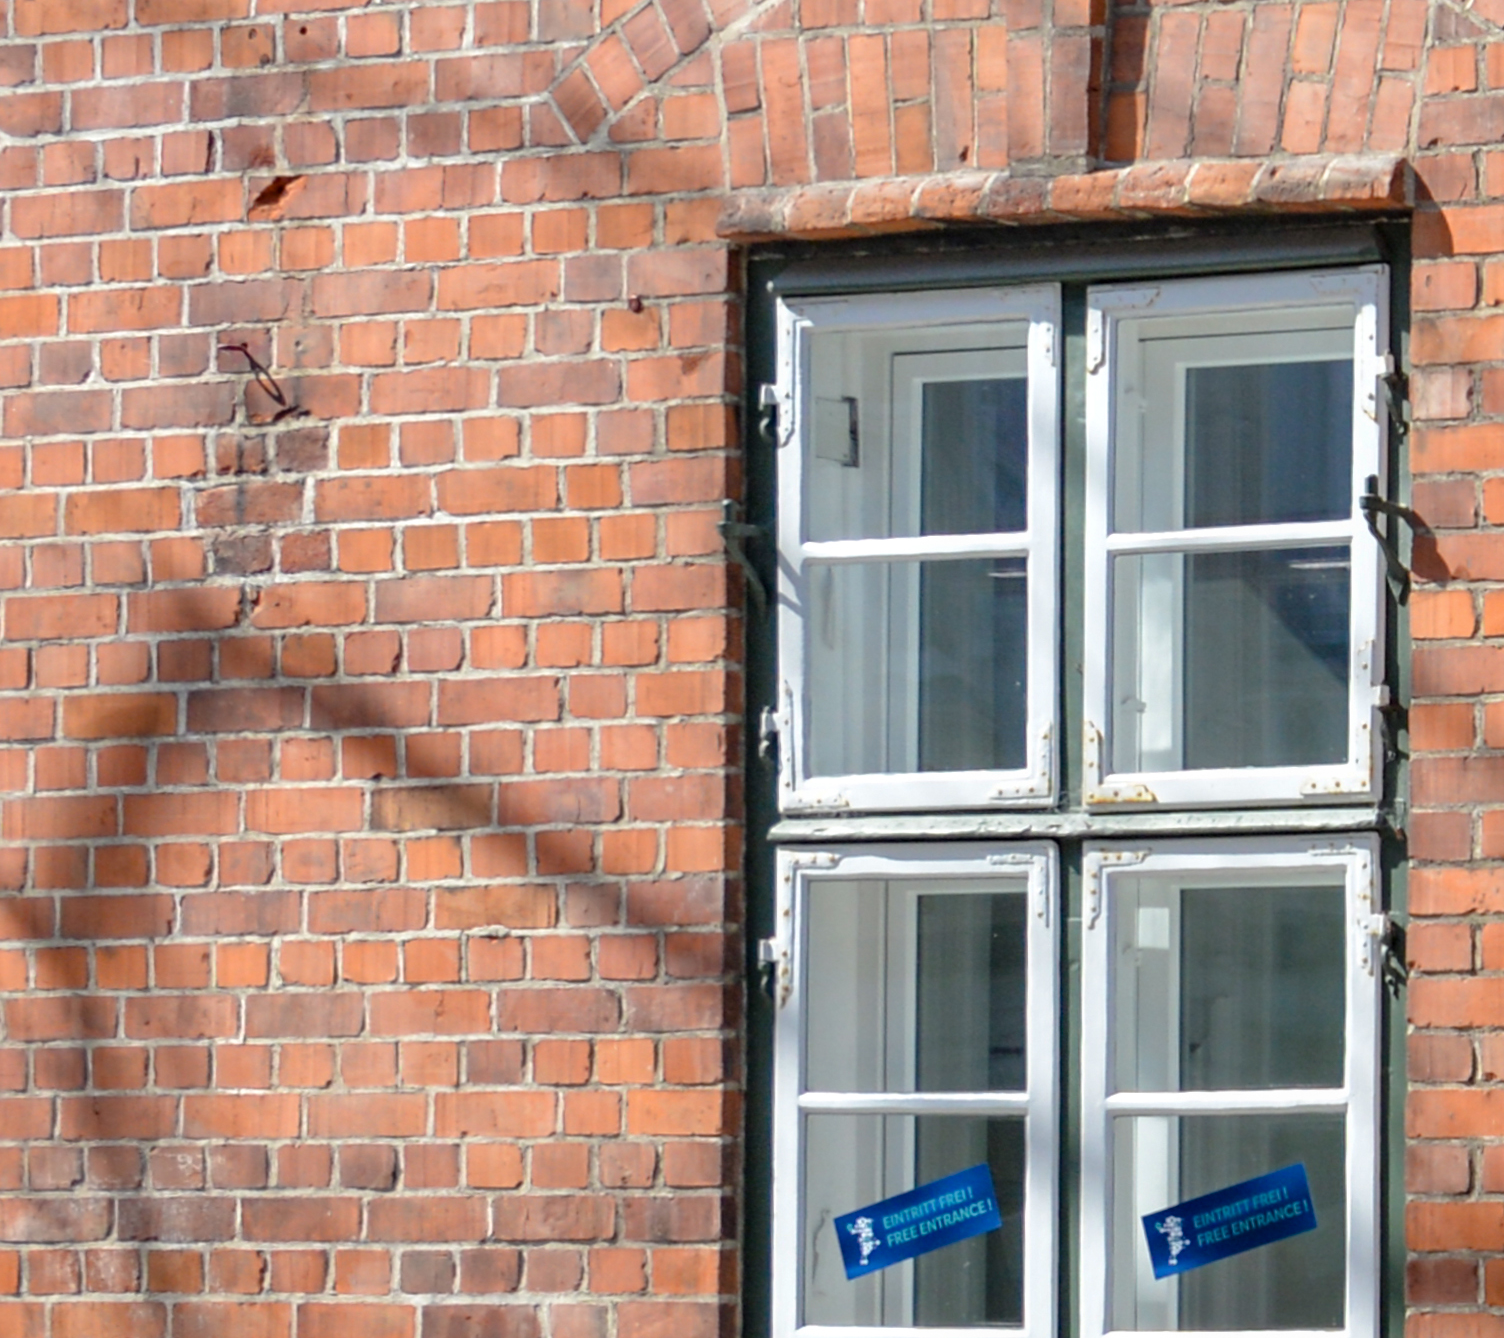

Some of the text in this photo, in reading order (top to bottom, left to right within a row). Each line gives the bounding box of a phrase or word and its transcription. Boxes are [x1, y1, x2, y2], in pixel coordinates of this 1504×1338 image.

[882, 1198, 937, 1230] EINTRITT
[1193, 1198, 1250, 1229] EINTRITT
[886, 1225, 919, 1248] FREE
[1197, 1224, 1231, 1248] FREE
